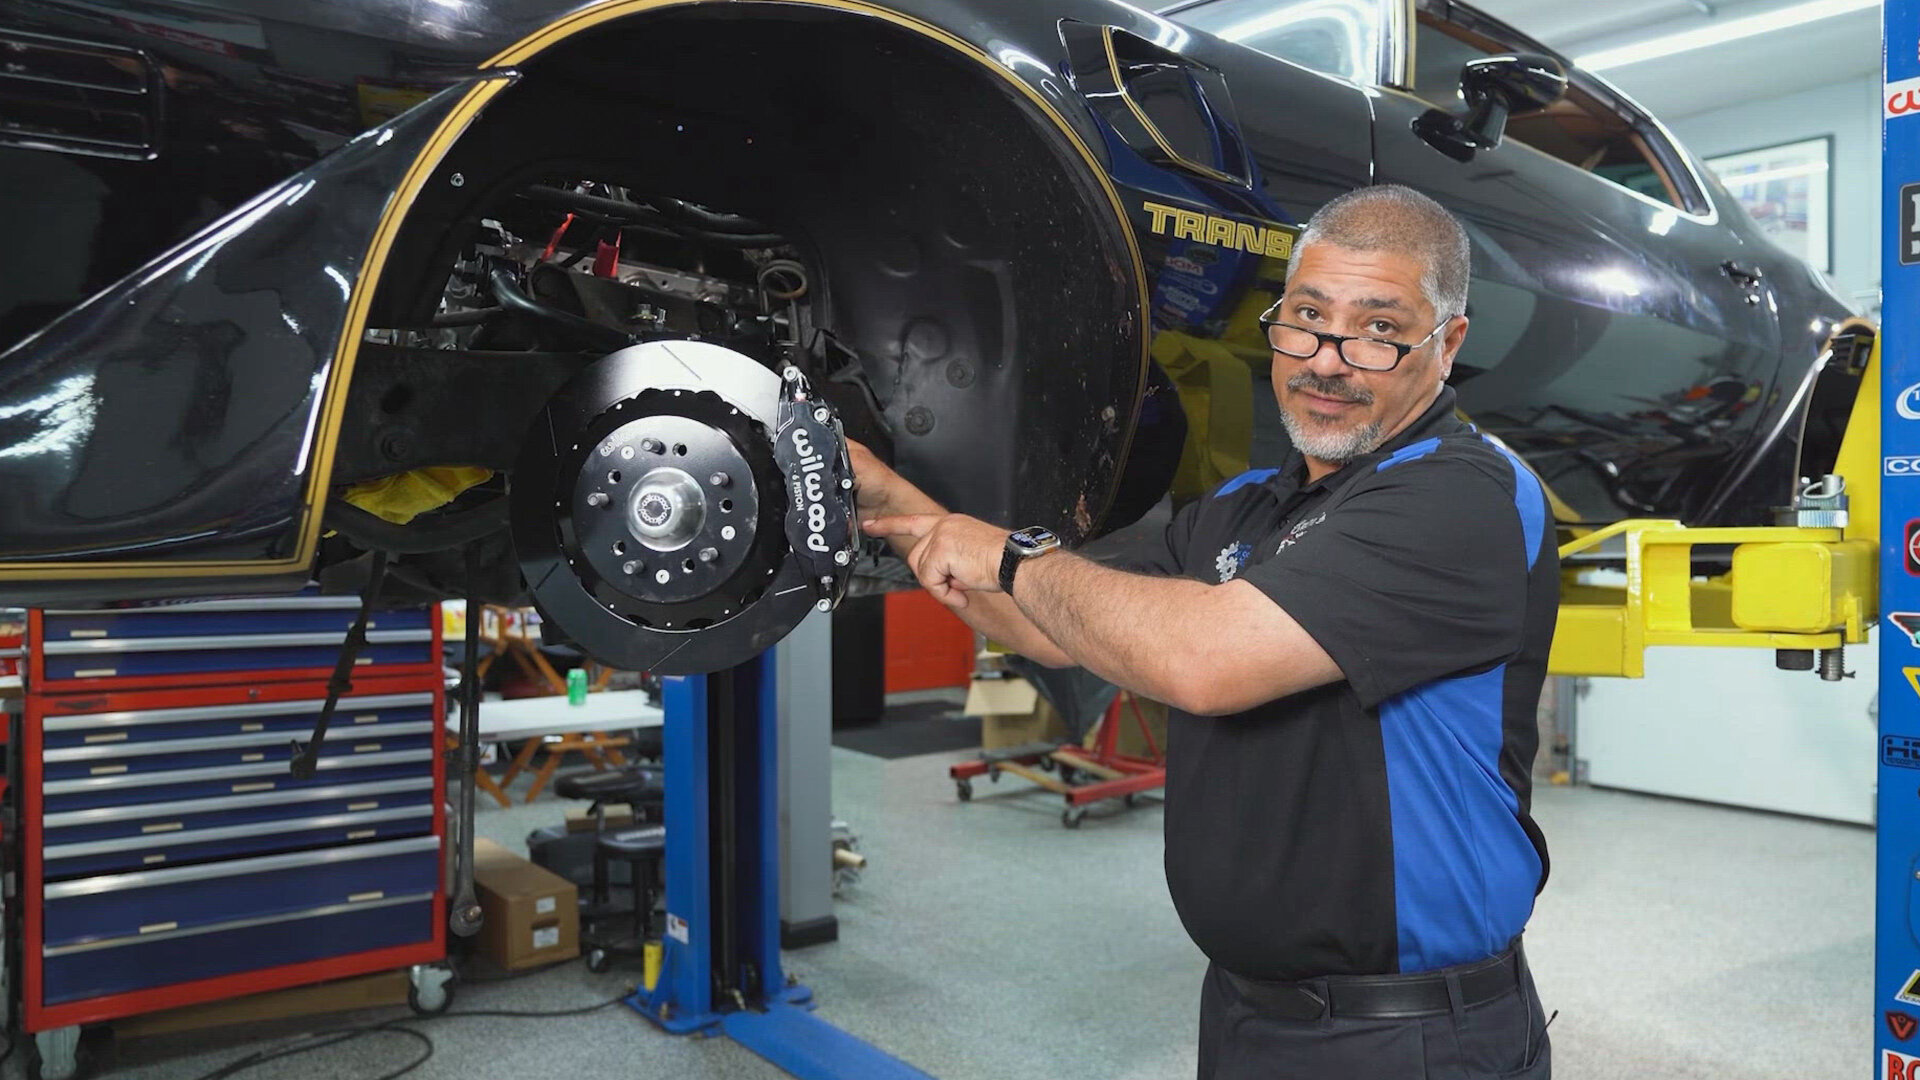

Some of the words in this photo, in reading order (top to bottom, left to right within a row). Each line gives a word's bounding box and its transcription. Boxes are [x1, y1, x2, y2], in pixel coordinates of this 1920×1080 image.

[1143, 201, 1294, 260] TRANS
[791, 428, 830, 552] wilwood
[793, 482, 805, 511] PISTON
